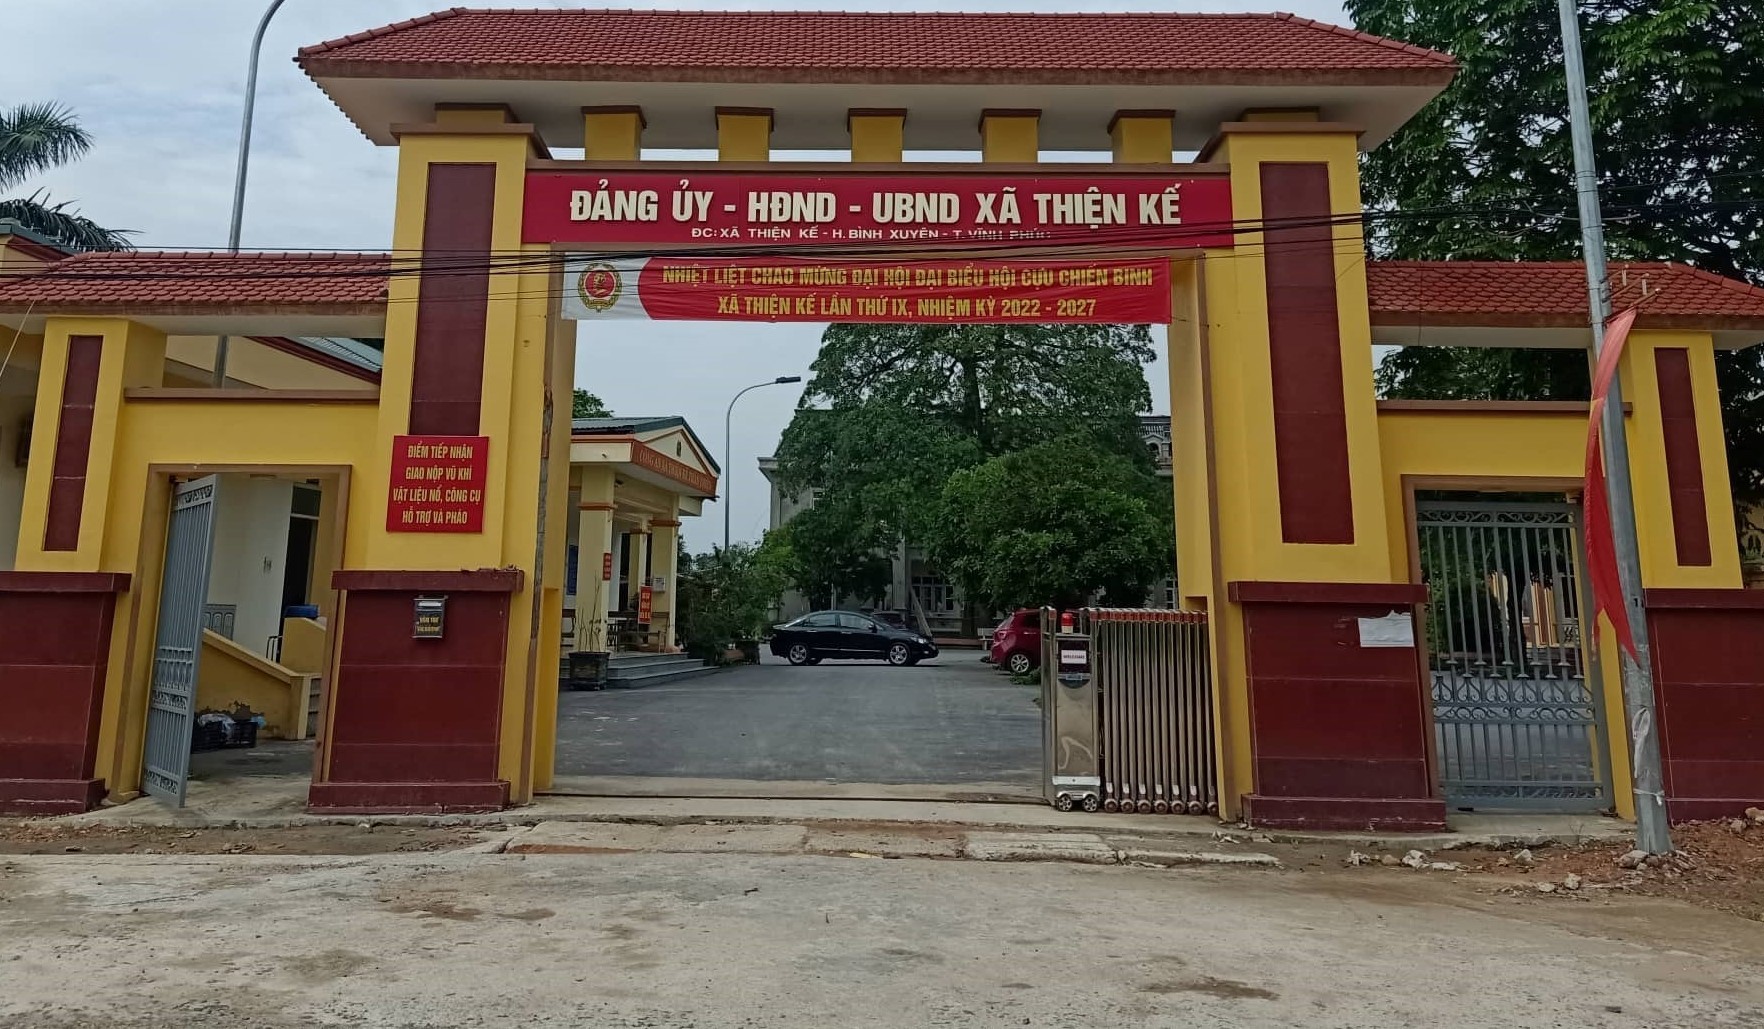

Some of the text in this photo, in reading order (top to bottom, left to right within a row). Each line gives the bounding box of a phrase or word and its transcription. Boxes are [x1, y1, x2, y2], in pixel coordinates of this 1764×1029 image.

[569, 179, 659, 222] ĐẢNG
[671, 179, 714, 222] ỦY
[748, 191, 836, 223] HĐND
[872, 192, 960, 224] UBND
[975, 186, 1021, 224] XÃ
[1033, 186, 1126, 229] THIỆN
[1139, 183, 1181, 225] KẾ
[748, 226, 791, 241] THIỆN
[799, 225, 819, 239] KẾ
[889, 227, 939, 239] XUYÊN
[663, 263, 710, 287] NHIỆT
[714, 264, 747, 288] LIỆT
[799, 265, 847, 285] MỪNG
[851, 268, 879, 290] ĐẠI
[883, 265, 910, 290] HỘI
[947, 262, 984, 287] BIỂU
[988, 265, 1016, 290] HỘI
[1021, 267, 1054, 290] CỰU
[1058, 263, 1108, 287] CHIẾN
[717, 293, 740, 314] XÃ
[744, 293, 791, 318] THIỆN
[795, 292, 816, 315] KẾ
[820, 291, 852, 315] LẦN
[856, 294, 889, 316] THỨ
[892, 298, 912, 318] IX,
[917, 295, 970, 321] NHIỆM
[975, 295, 996, 317] KỲ
[1001, 298, 1041, 317] 2022
[1057, 298, 1097, 317] 2027
[407, 440, 473, 462] ĐIỂM TIẾP NHẬN
[405, 466, 425, 480] GIAO
[426, 464, 444, 483] NỘP
[445, 465, 457, 481] VŨ
[393, 485, 409, 504] VẬT
[409, 486, 427, 505] LIỆU
[445, 486, 468, 502] CÔNG
[469, 489, 481, 505] CỤ
[415, 509, 432, 527] TRỢ
